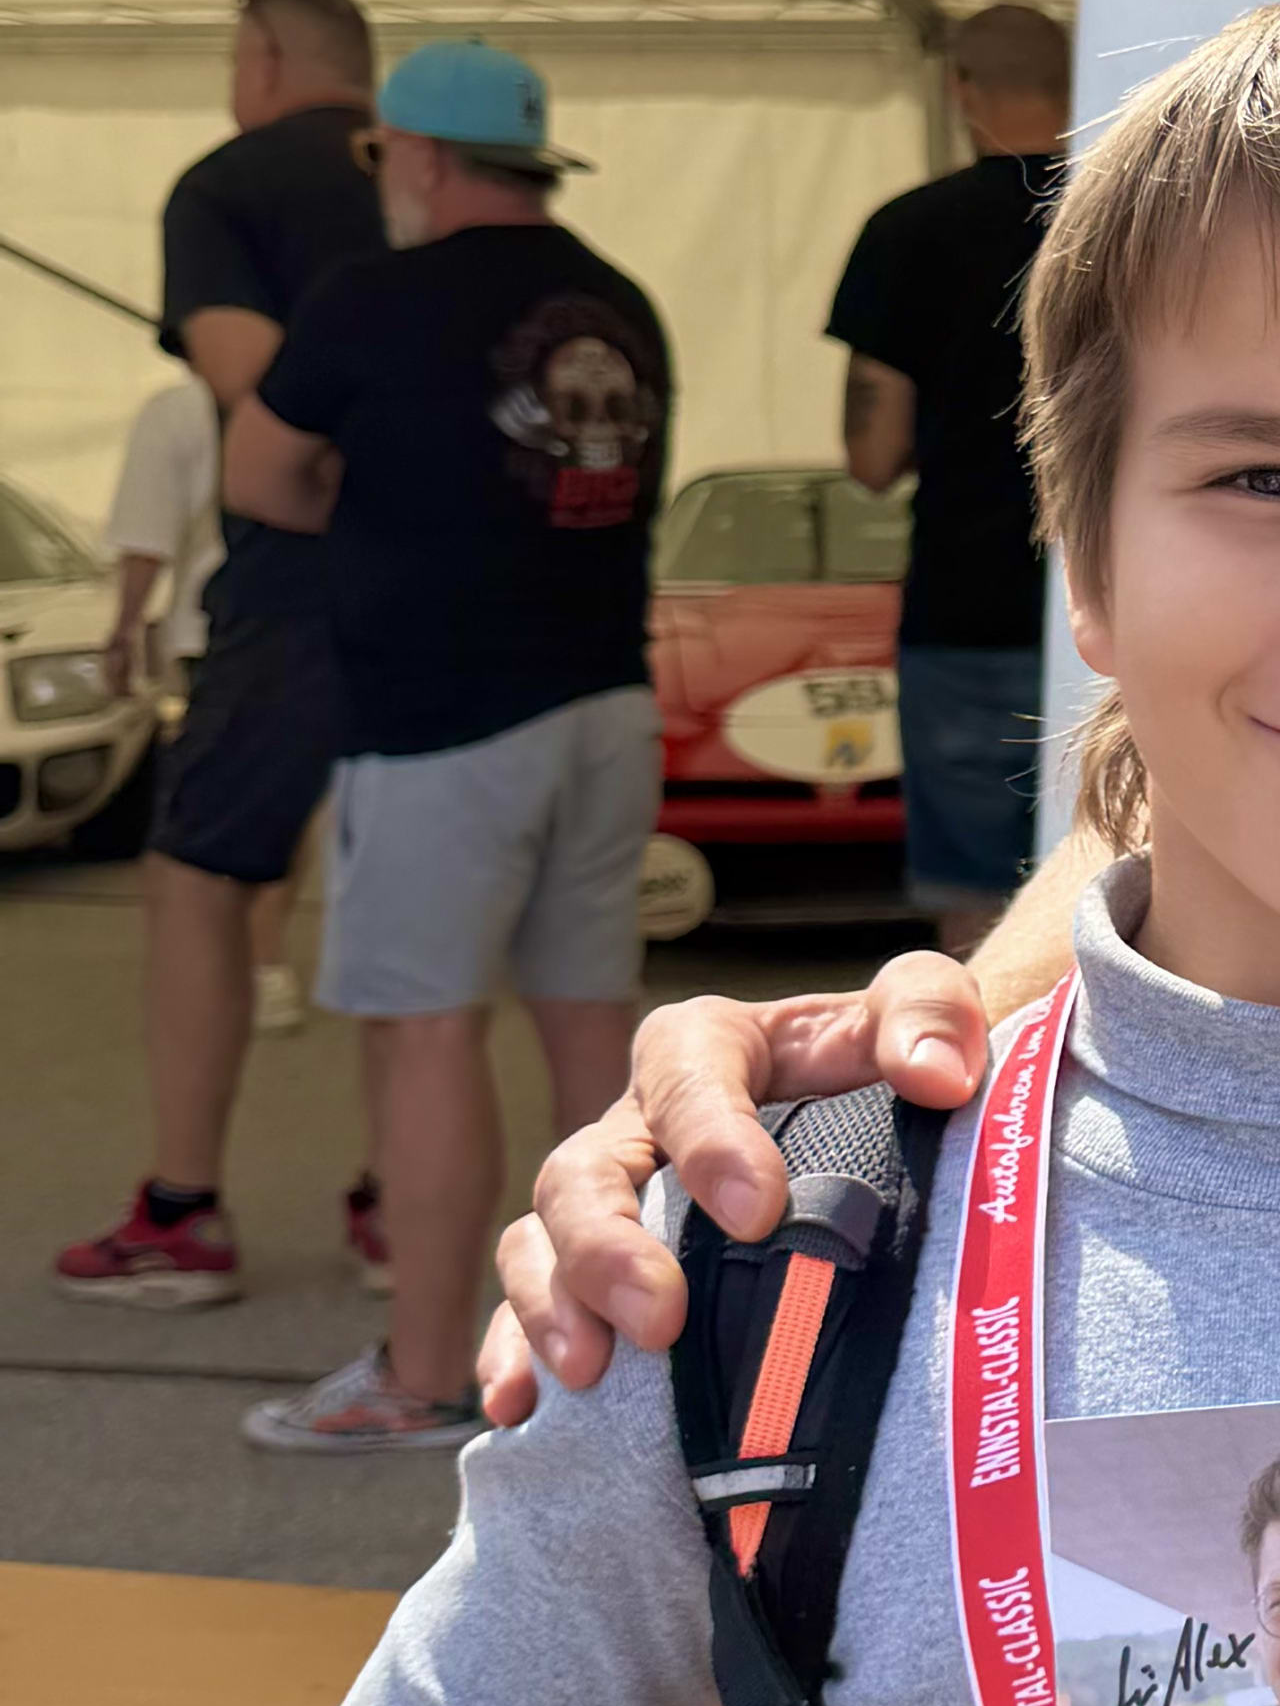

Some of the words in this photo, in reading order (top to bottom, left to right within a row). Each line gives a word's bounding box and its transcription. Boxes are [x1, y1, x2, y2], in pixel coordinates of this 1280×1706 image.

[978, 1064, 1037, 1225] Autofahren
[1018, 1025, 1048, 1061] im
[969, 1296, 1021, 1489] ENNSTAL-CLASSIC
